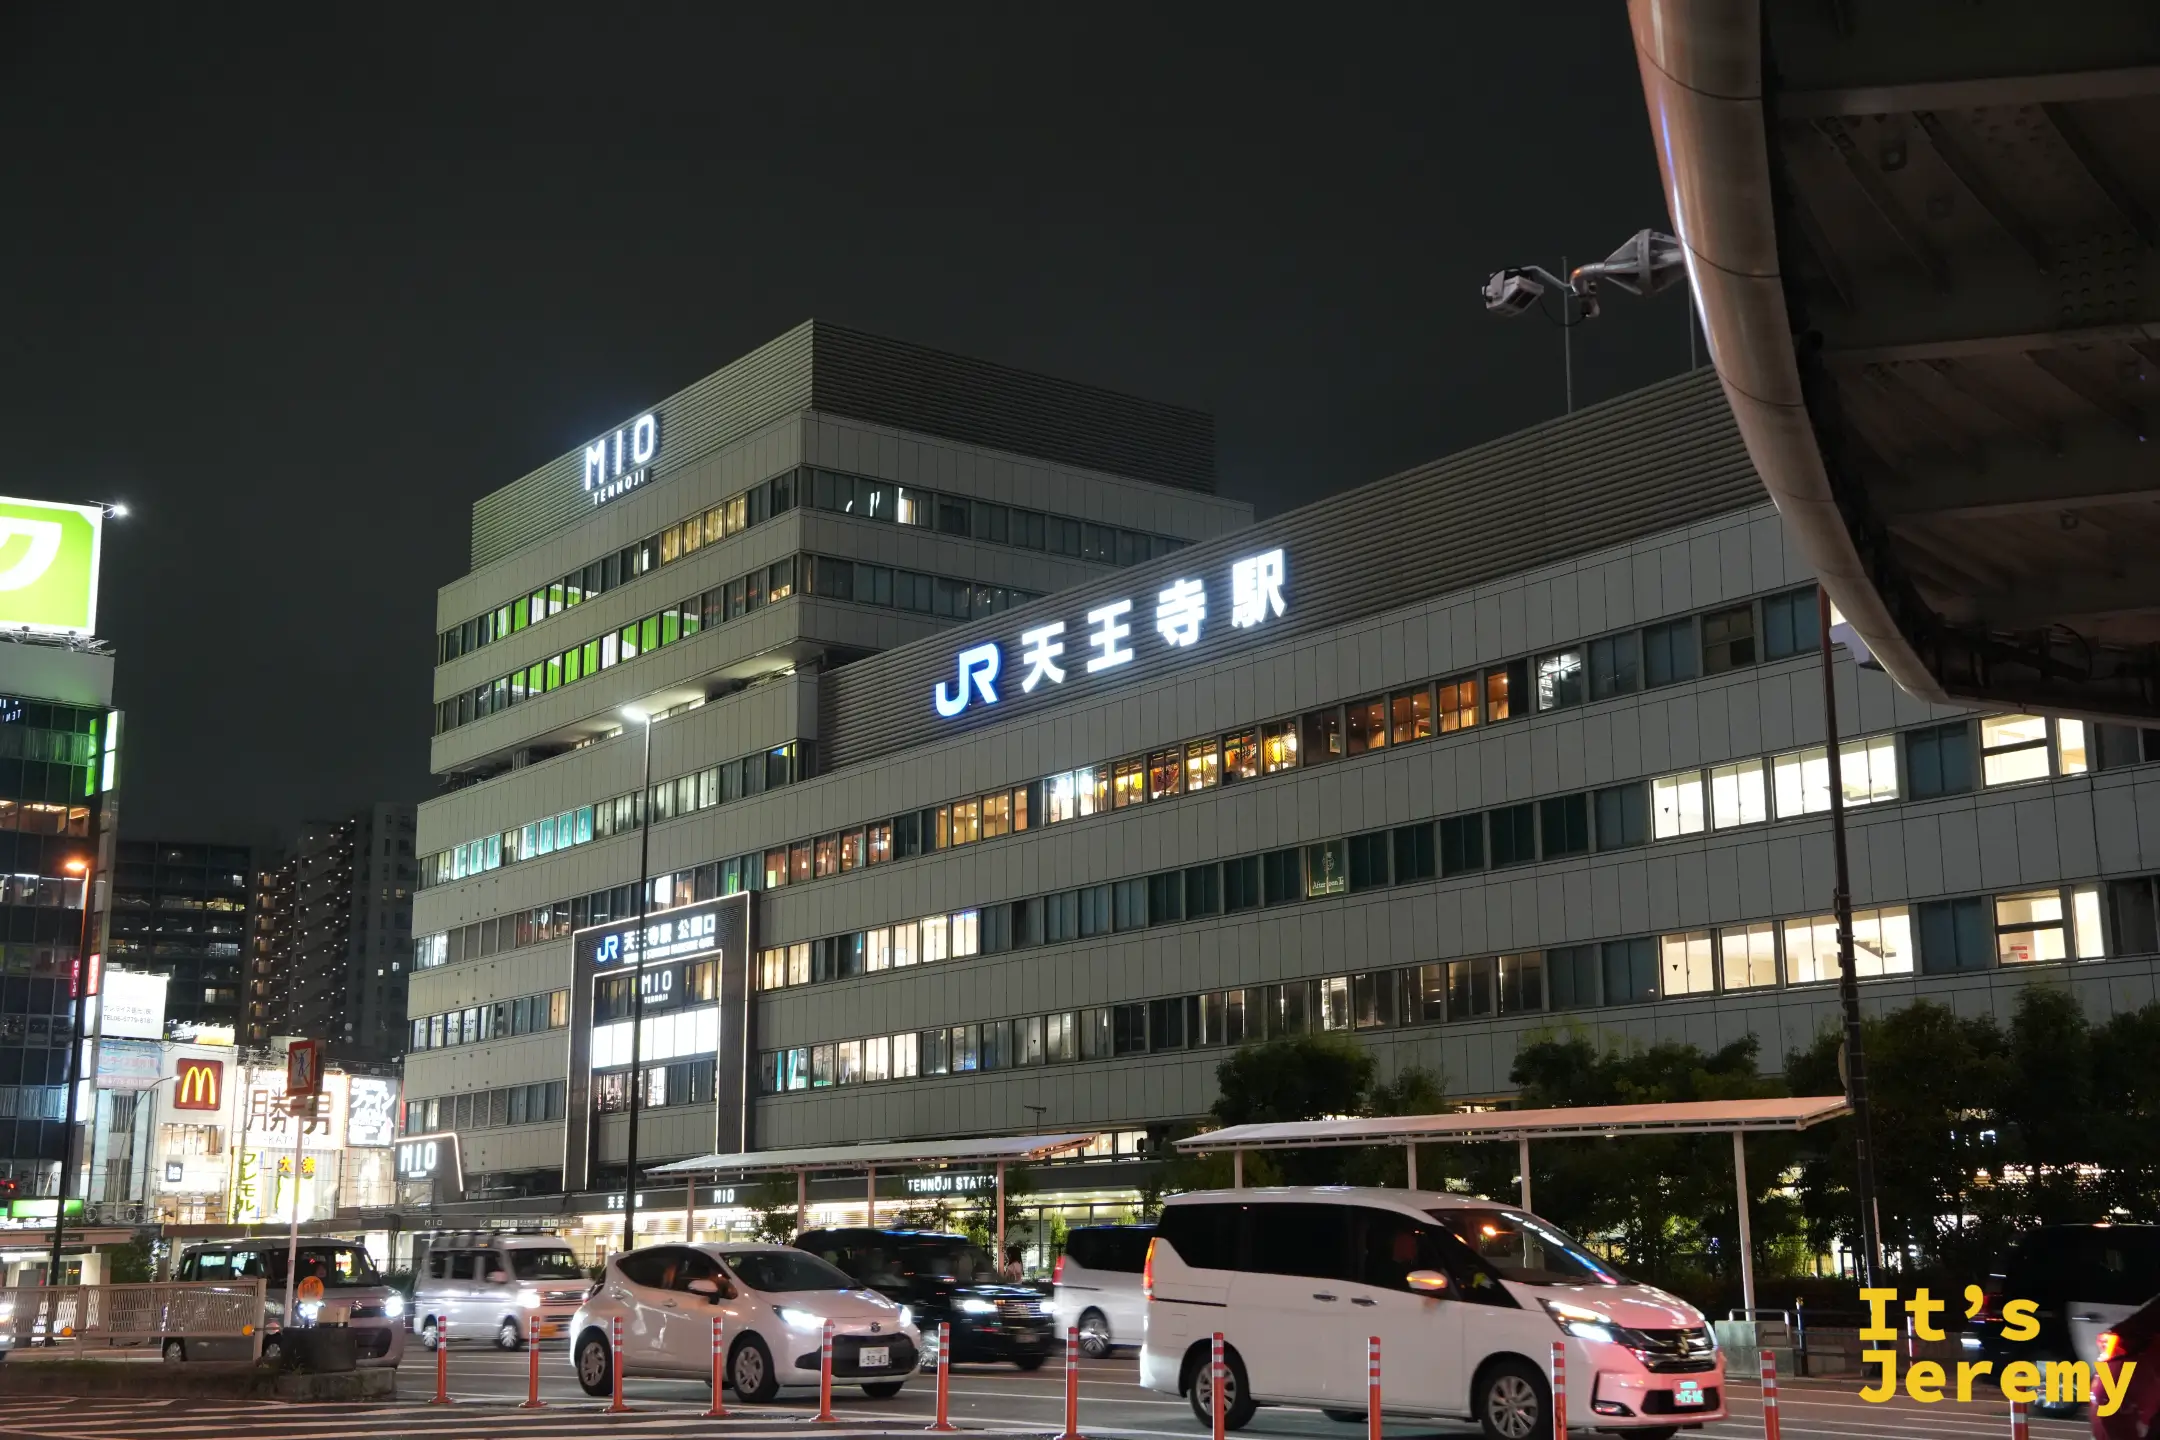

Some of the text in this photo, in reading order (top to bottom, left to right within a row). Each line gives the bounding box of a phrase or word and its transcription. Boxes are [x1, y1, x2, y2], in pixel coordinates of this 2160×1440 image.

[584, 414, 655, 491] MIO
[593, 469, 645, 505] TENNOJI
[935, 548, 1286, 718] JR 天王寺駅
[596, 934, 619, 963] JR
[641, 970, 672, 995] MIO
[400, 1141, 437, 1172] MIO
[713, 1188, 735, 1204] MIO
